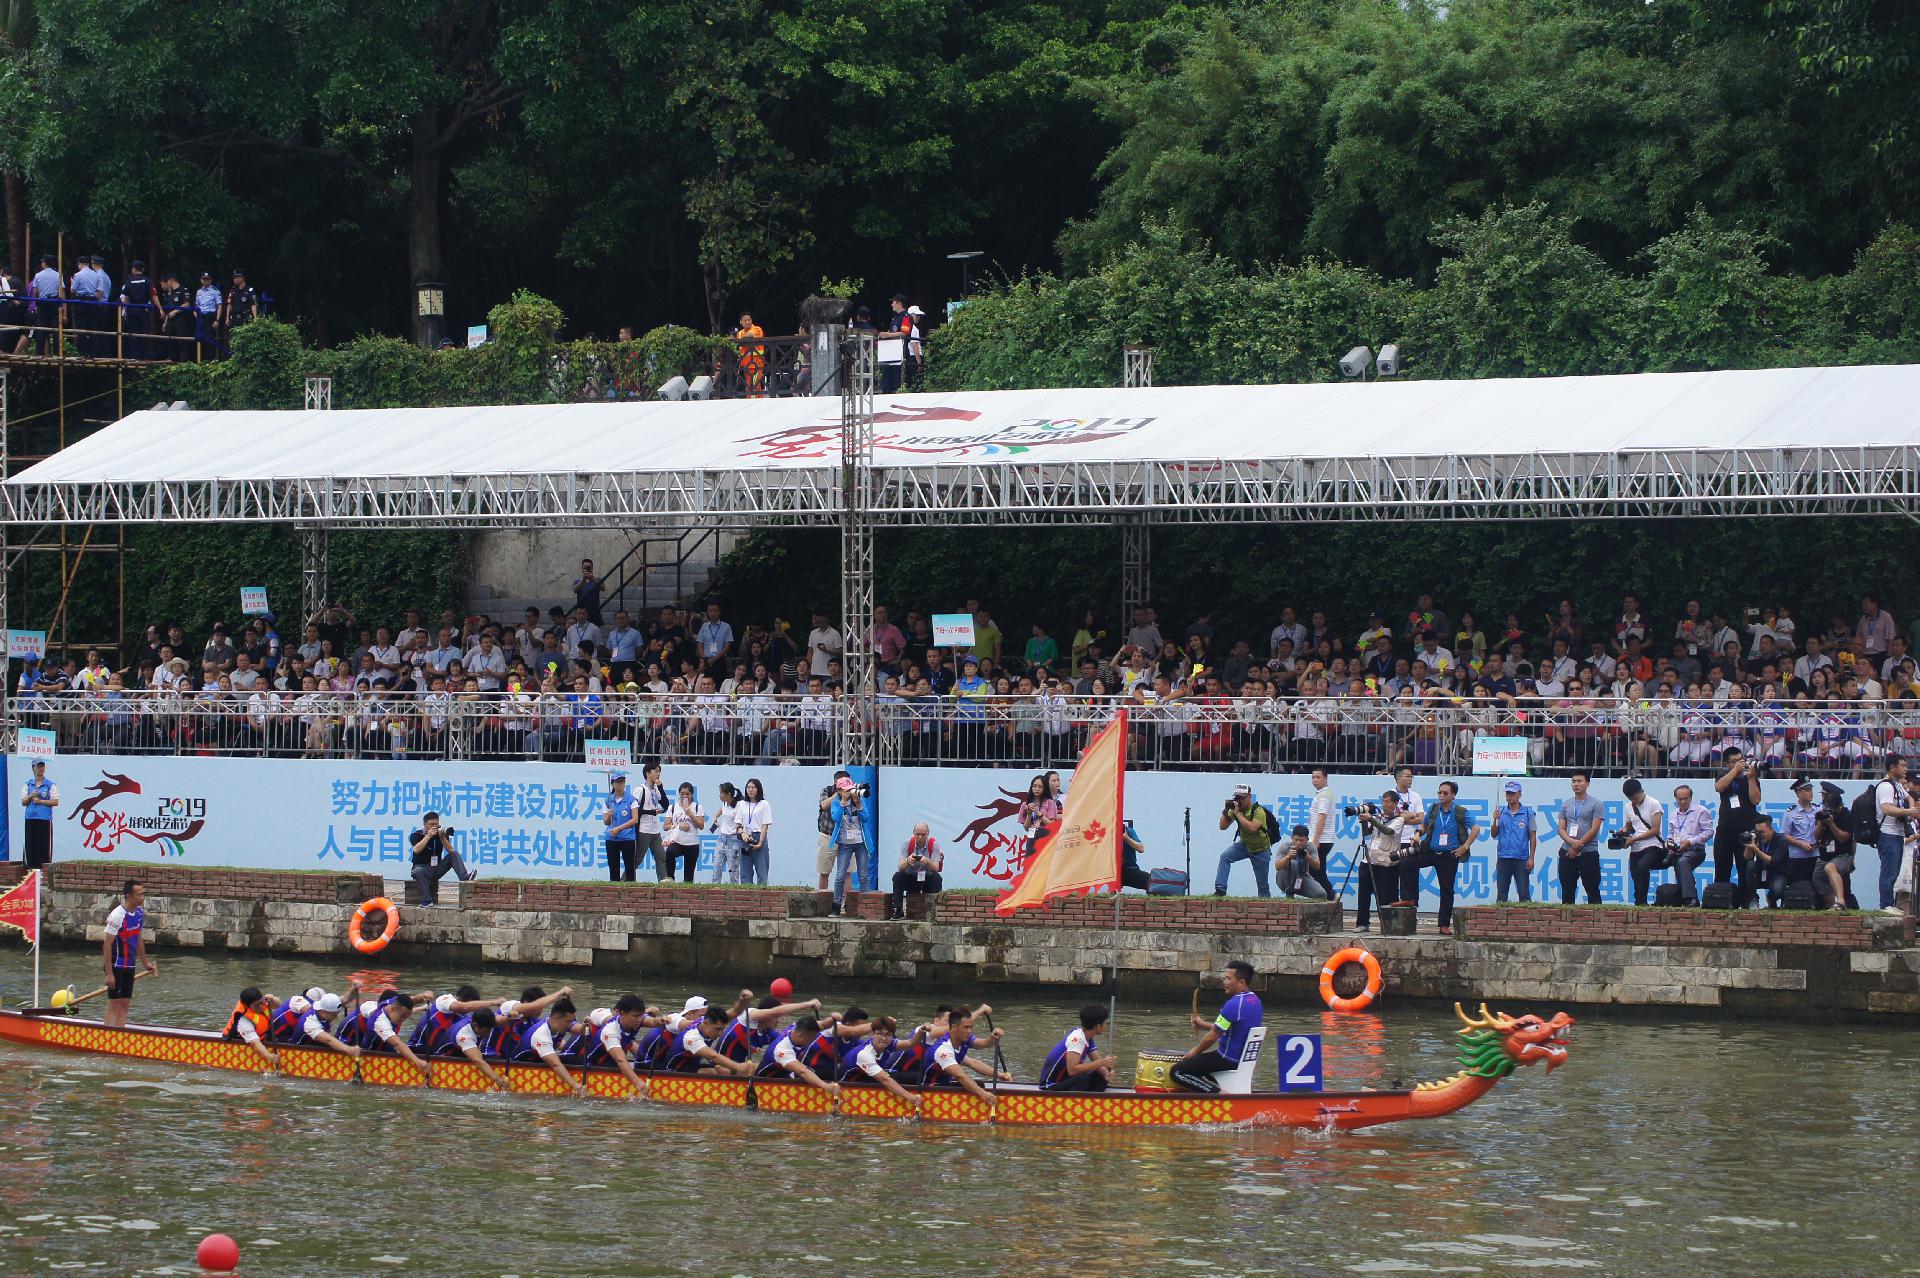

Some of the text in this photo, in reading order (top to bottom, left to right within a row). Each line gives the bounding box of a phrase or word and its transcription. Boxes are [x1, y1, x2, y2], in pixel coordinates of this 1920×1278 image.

[1000, 417, 1158, 435] 2019
[158, 797, 206, 818] 2019
[1285, 1036, 1316, 1084] 2
